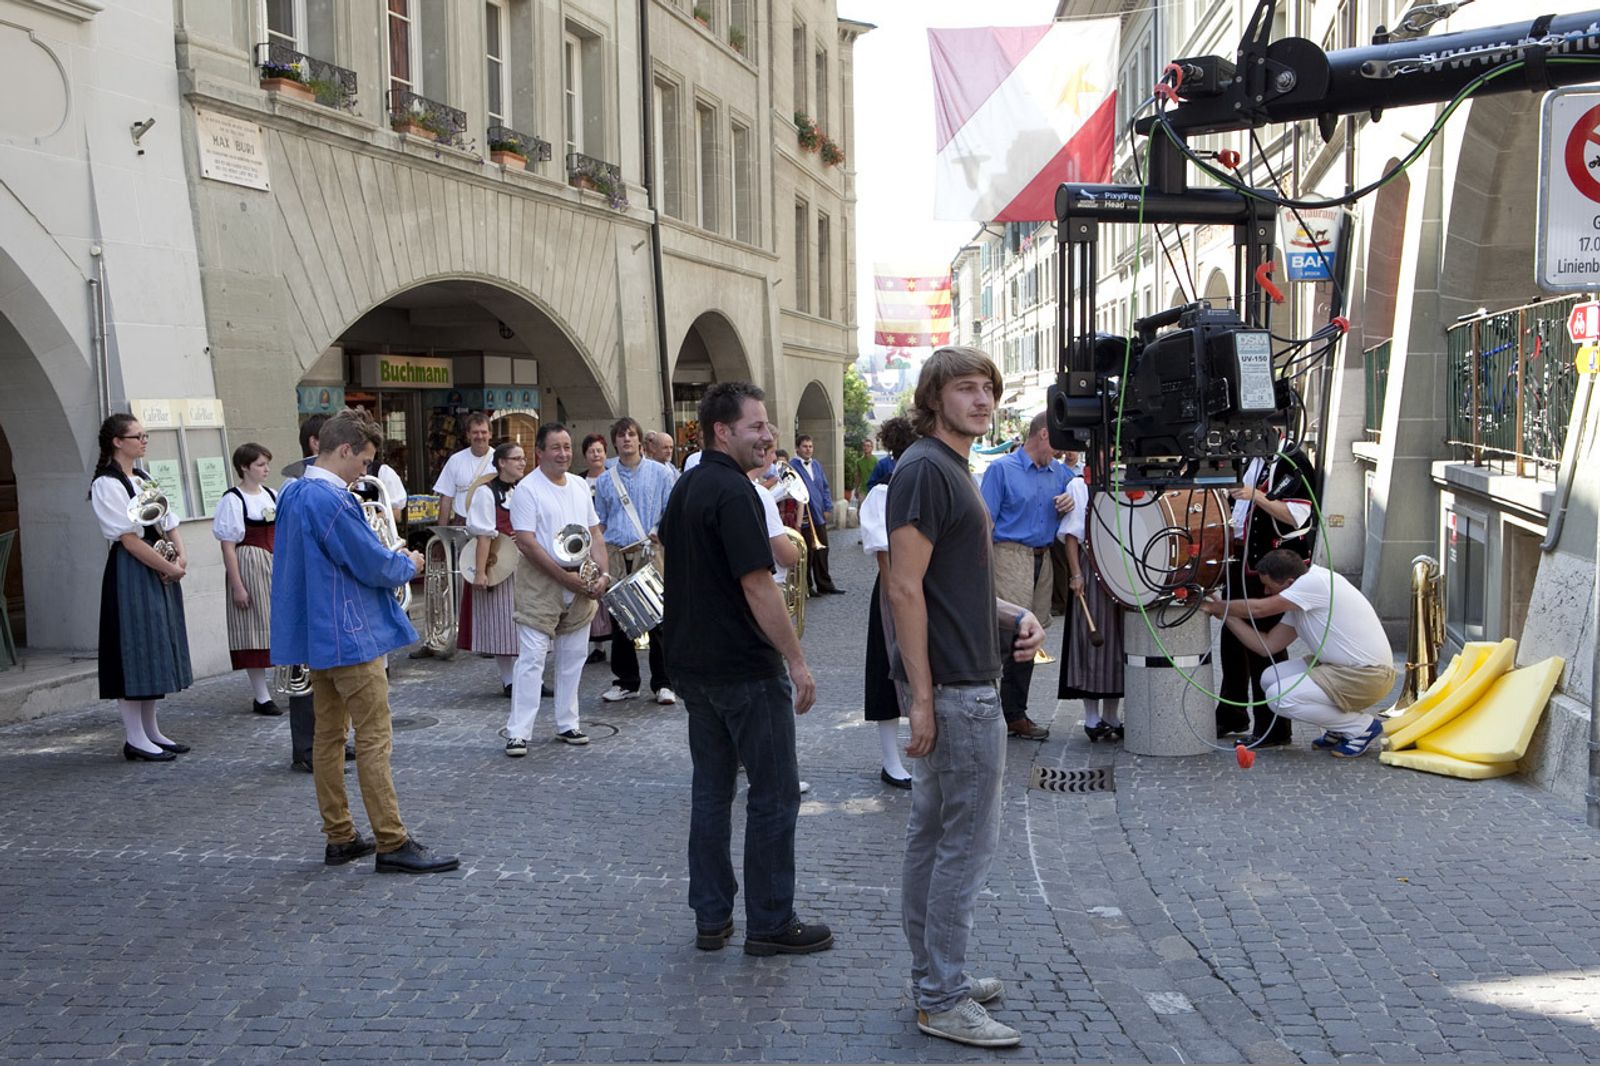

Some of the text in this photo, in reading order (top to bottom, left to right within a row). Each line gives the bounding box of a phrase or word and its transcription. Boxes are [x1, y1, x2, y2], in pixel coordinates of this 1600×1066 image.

[212, 135, 255, 155] MAX BURI
[1104, 200, 1125, 208] Head
[1579, 236, 1600, 251] 17.0
[1557, 257, 1600, 274] Linienb
[380, 360, 449, 384] Buchmann
